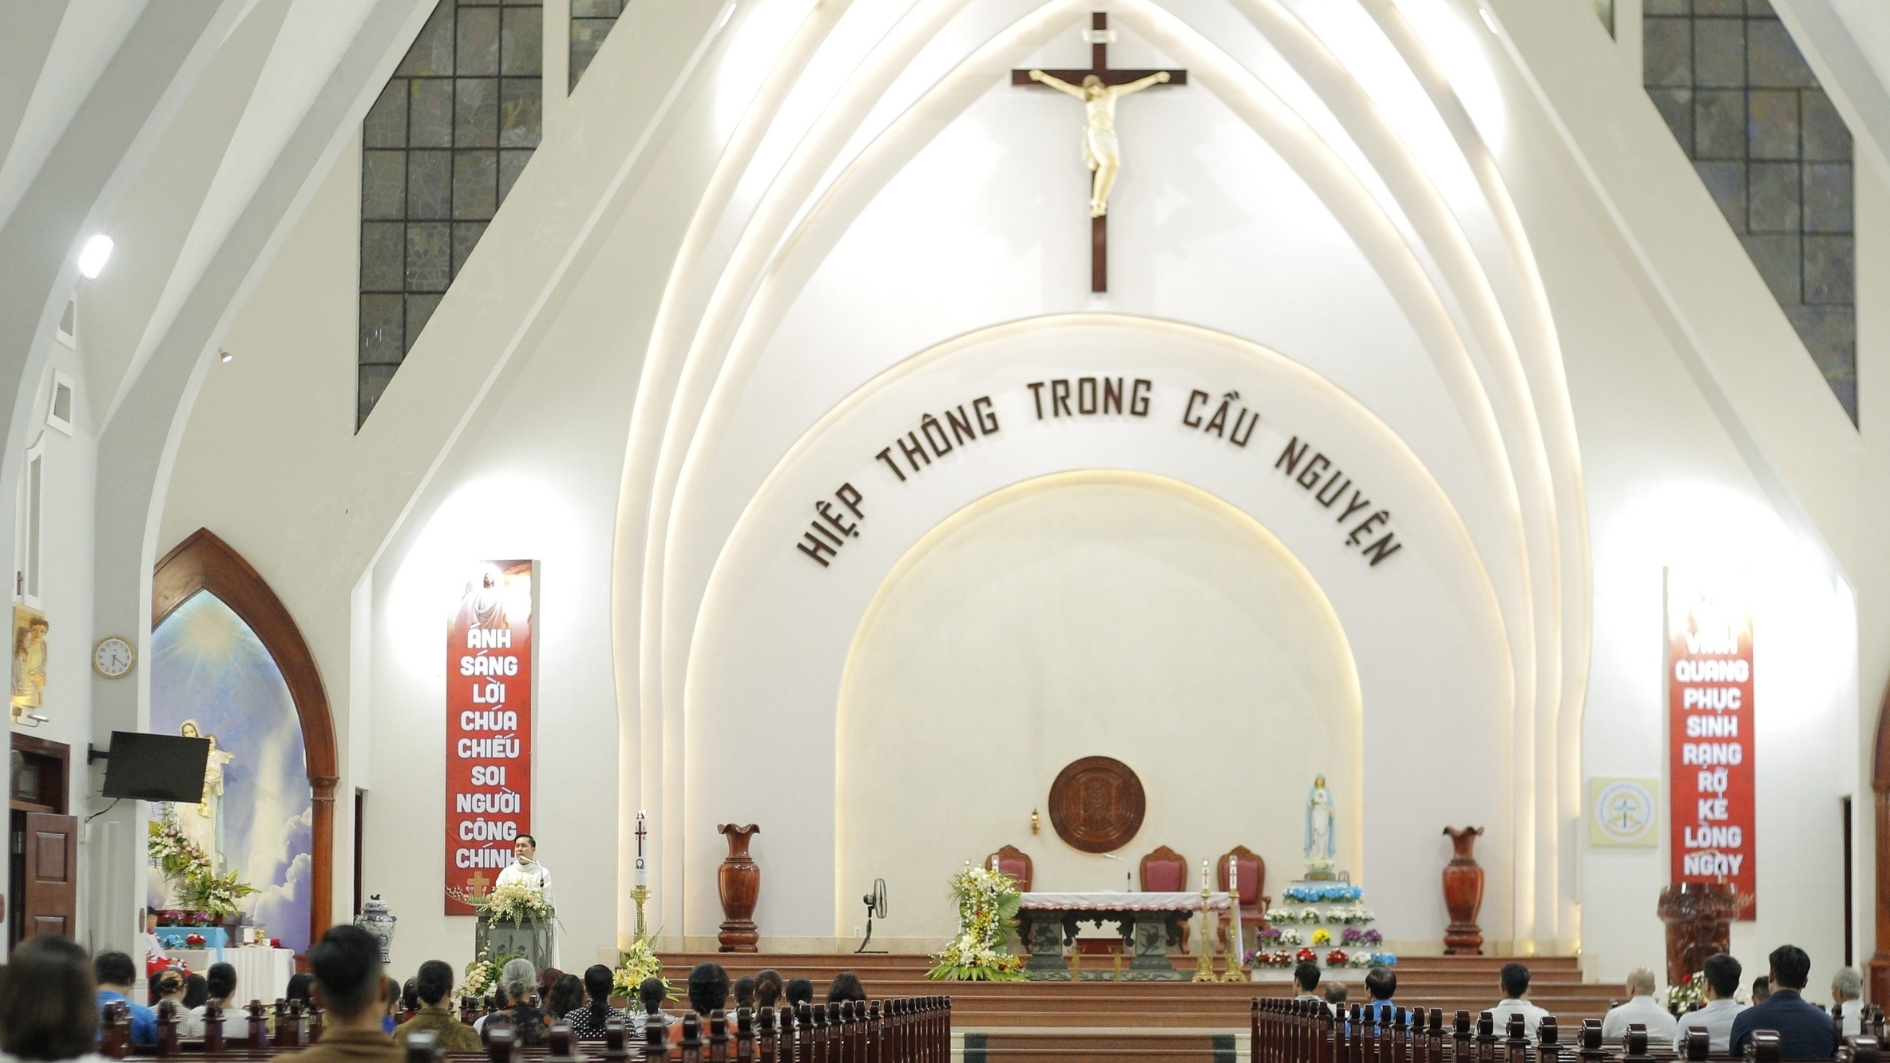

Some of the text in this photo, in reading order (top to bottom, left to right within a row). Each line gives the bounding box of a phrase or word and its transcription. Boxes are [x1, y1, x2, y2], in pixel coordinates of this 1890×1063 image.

[796, 377, 1403, 568] HIỆP THÔNG TRONG CẦU NGUYỆN
[467, 622, 511, 648] ÁNH
[460, 649, 518, 676] SÁNG
[1675, 659, 1749, 683] QUANG
[472, 676, 505, 703] LỜI
[1683, 687, 1742, 714] PHỤC
[460, 704, 517, 731] CHÚA
[1686, 714, 1739, 738] SINH
[457, 733, 520, 758] CHIẾU
[1682, 742, 1742, 769] RẠNG
[471, 766, 506, 786] SOI
[456, 786, 520, 813] NGƯỜI
[459, 817, 517, 841] CÔNG
[1684, 819, 1742, 848] LÒNG
[1683, 853, 1744, 876] NGAY
